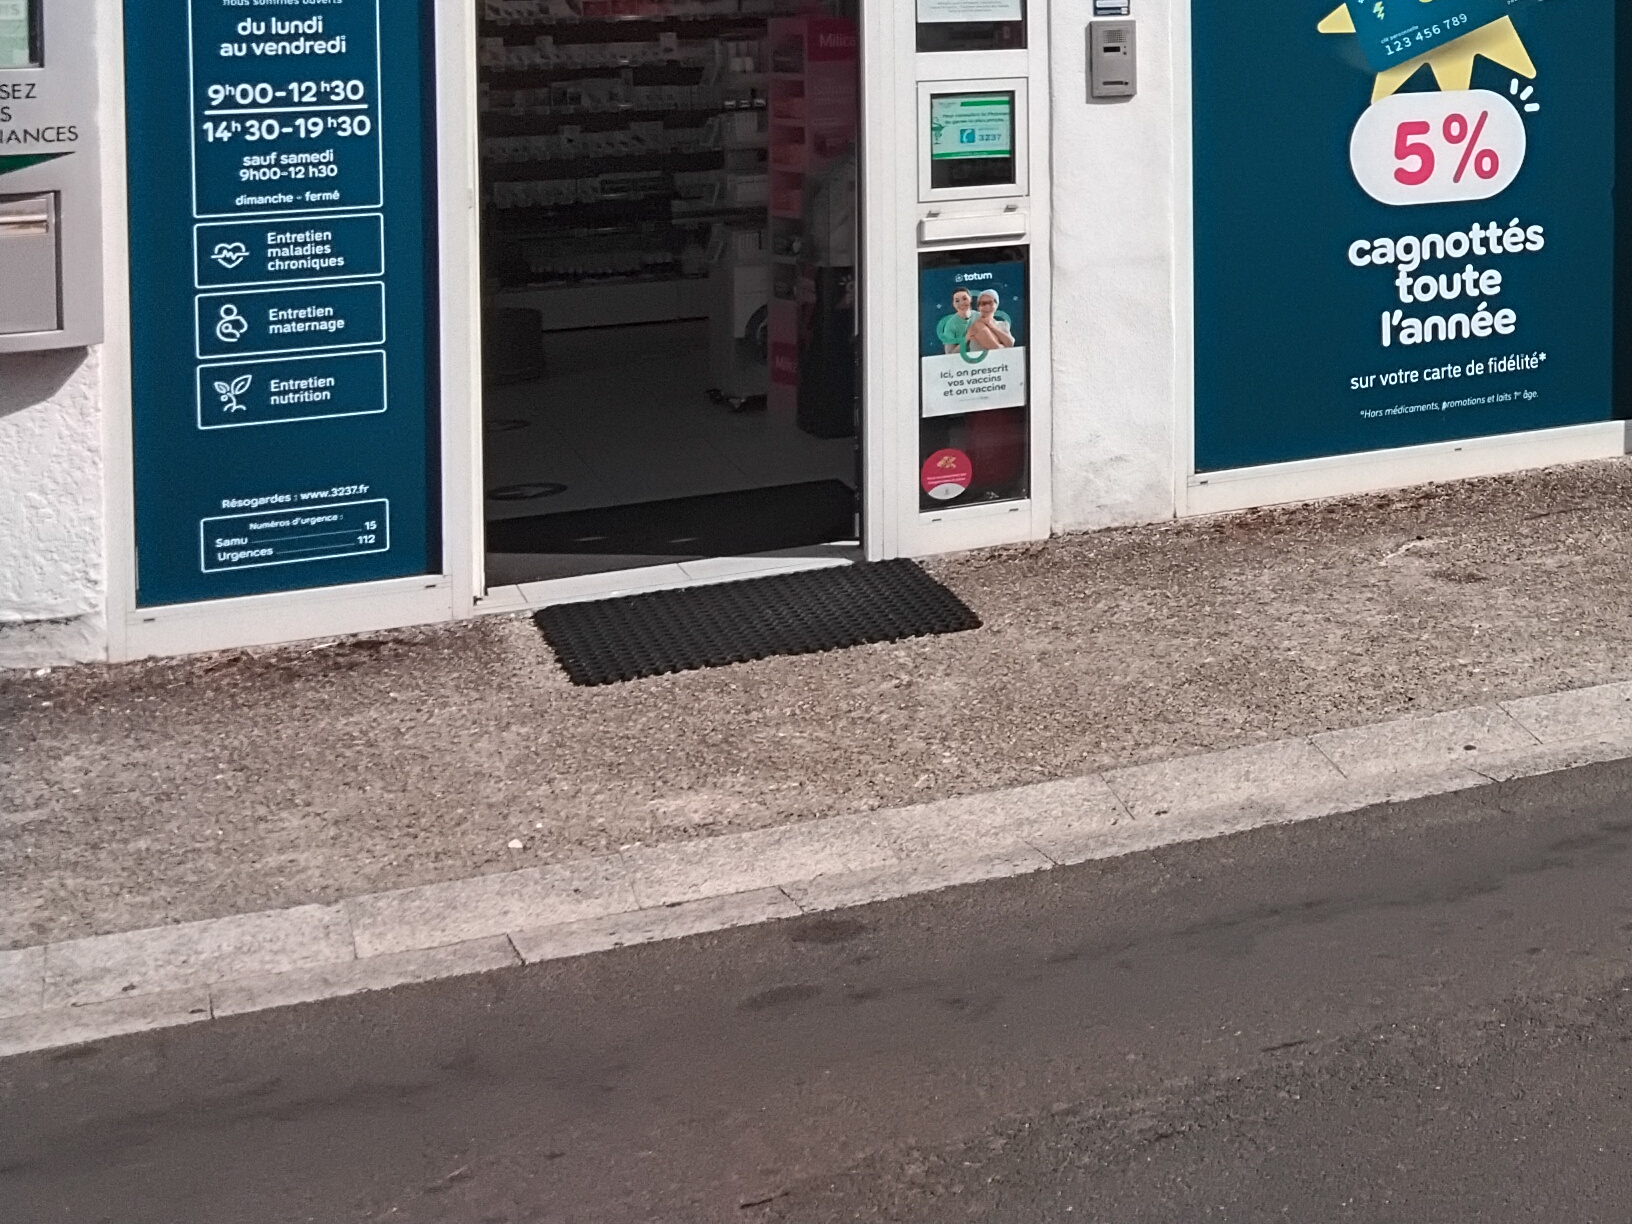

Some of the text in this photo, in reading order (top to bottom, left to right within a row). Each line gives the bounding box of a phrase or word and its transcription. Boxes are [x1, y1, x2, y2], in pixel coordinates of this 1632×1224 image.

[237, 15, 323, 35] du lundi
[1385, 13, 1468, 56] 123 456 789
[220, 35, 347, 57] au vendredi
[979, 133, 1002, 142] 3237
[1393, 110, 1500, 186] 5%
[243, 149, 334, 167] sauf samedi
[235, 192, 293, 206] dimanche
[304, 189, 340, 202] fermé
[267, 230, 332, 245] Entretien
[1348, 217, 1545, 273] cagnottés
[267, 243, 331, 258] maladies
[267, 256, 345, 271] chroniques
[964, 272, 993, 282] totum
[1395, 263, 1502, 304] toute
[269, 305, 333, 321] Entretien
[269, 319, 345, 334] maternage
[1381, 301, 1517, 347] l'année
[940, 369, 954, 379] Ici,
[971, 364, 1009, 377] prescrit
[1350, 375, 1377, 390] sur
[1380, 368, 1419, 386] votre
[1423, 363, 1462, 381] carte
[1465, 359, 1485, 376] de
[270, 376, 335, 392] Entretien
[947, 375, 1002, 387] vos vaccins
[270, 389, 331, 405] nutrition
[943, 389, 953, 397] et
[970, 383, 1006, 394] vaccine
[1385, 402, 1440, 416] médicaments,
[1441, 396, 1486, 412] promotions
[1487, 394, 1495, 403] et
[1496, 392, 1512, 403] laits
[1522, 388, 1539, 401] âge.
[222, 493, 291, 509] Résogardes
[300, 484, 370, 501] www.3237.fr
[249, 518, 290, 531] Numéros
[291, 514, 338, 527] d'urgence
[215, 521, 377, 548] Samu 15
[217, 534, 376, 562] Urgences 112
